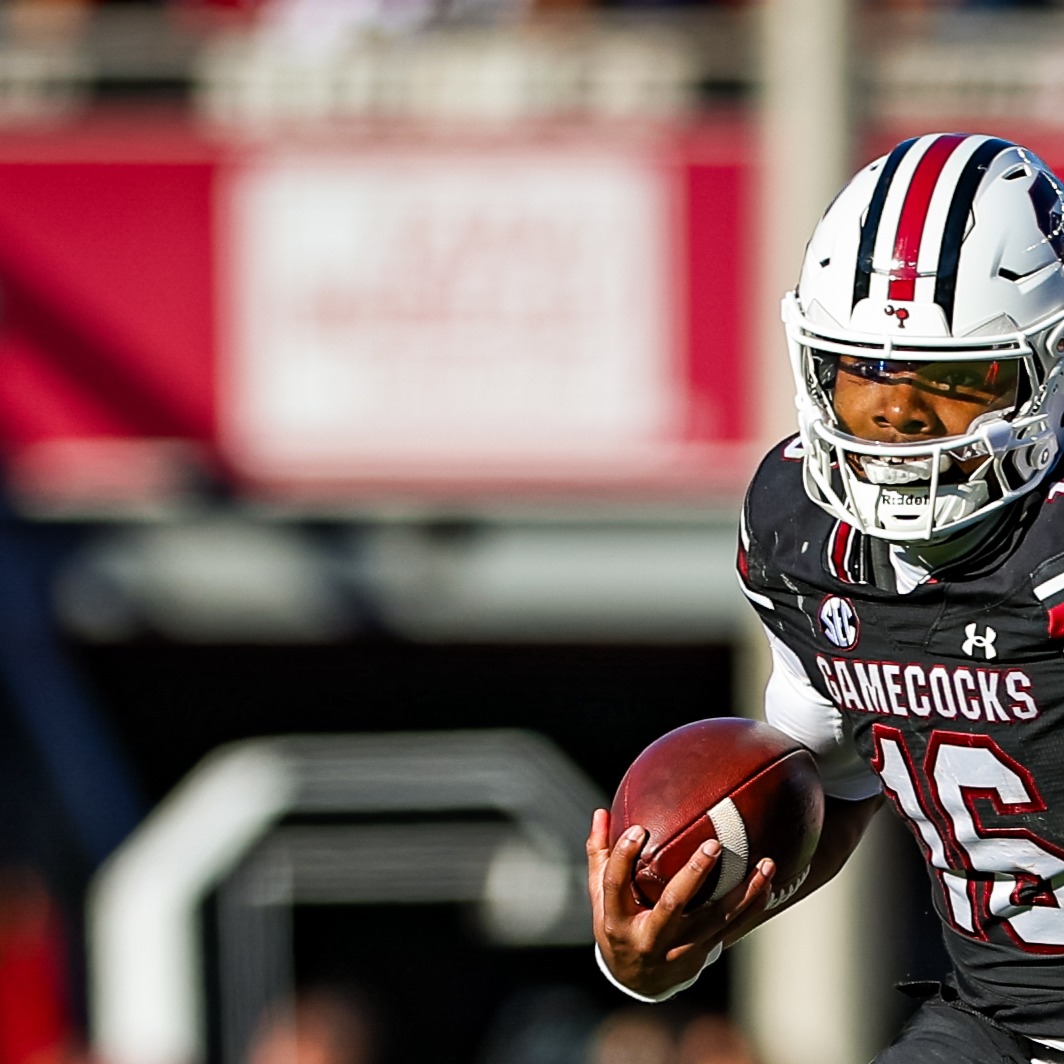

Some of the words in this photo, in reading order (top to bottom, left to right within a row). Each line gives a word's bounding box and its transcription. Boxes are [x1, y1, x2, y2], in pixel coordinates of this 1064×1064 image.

[882, 494, 930, 505] Riddel
[820, 596, 857, 648] SEC
[815, 653, 1041, 724] GAMECOCKS
